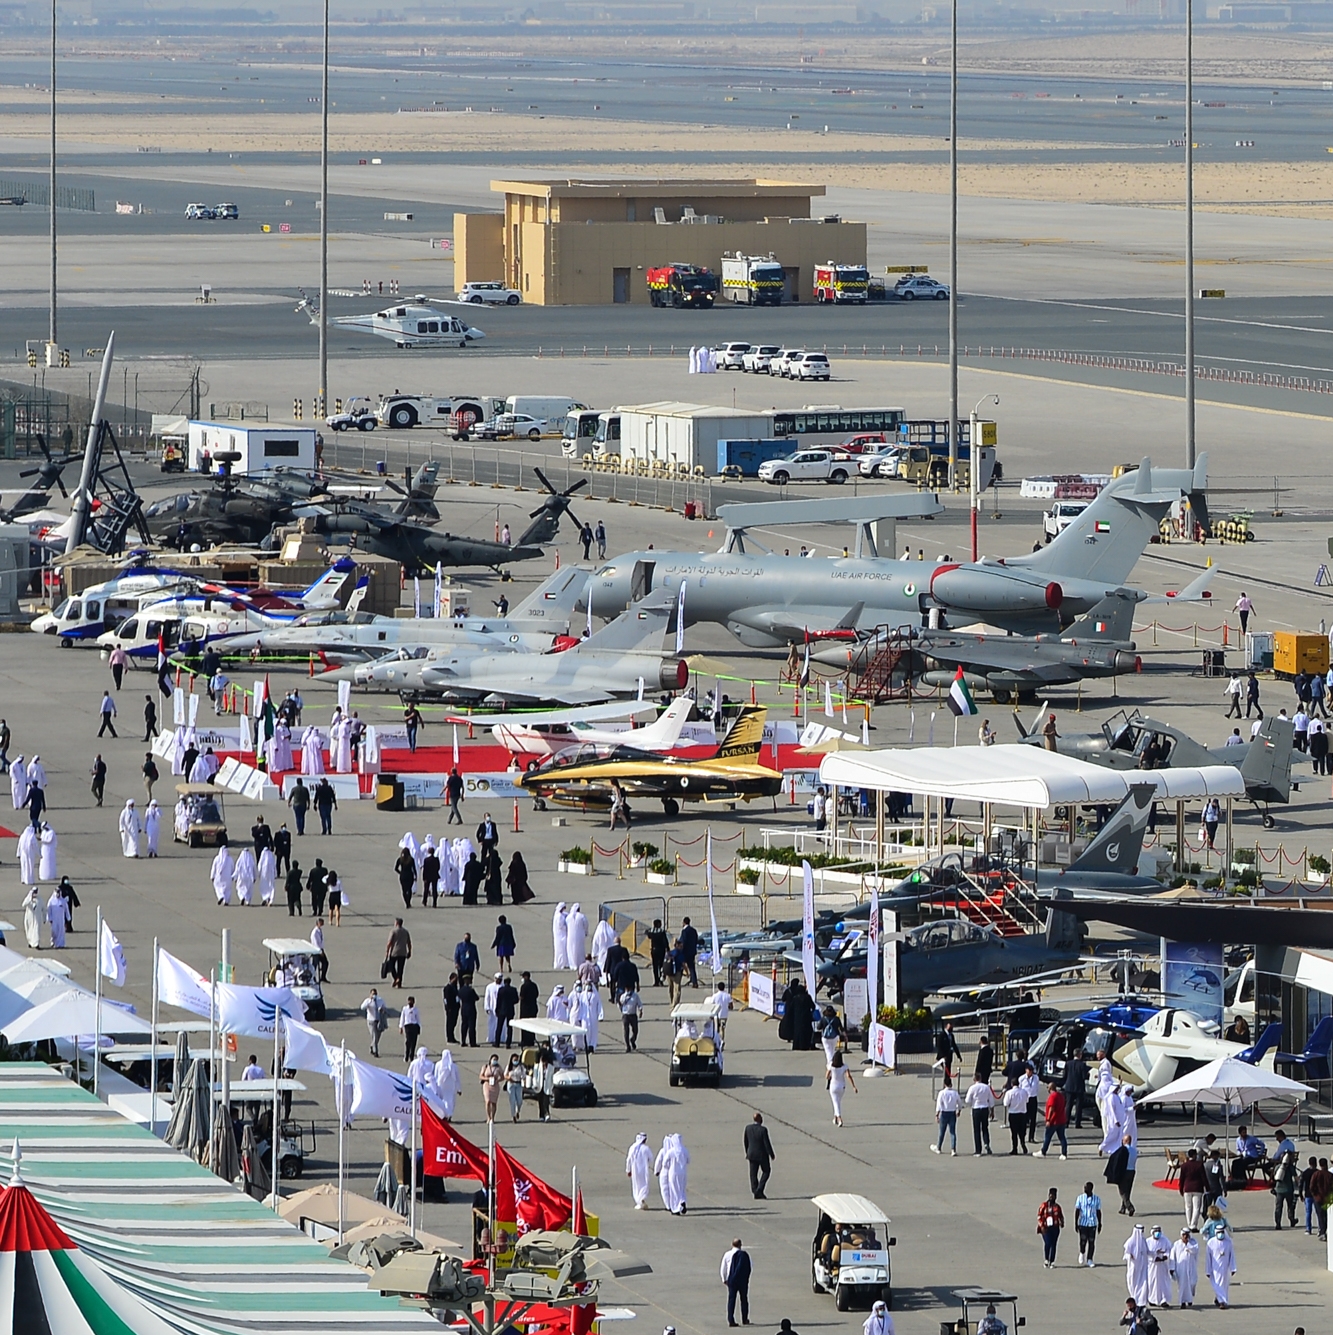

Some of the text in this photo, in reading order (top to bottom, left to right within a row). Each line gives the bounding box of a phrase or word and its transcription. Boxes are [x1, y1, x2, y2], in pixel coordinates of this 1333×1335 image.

[831, 571, 848, 579] UAE
[863, 572, 893, 582] FORCE
[722, 746, 756, 758] FURSAN
